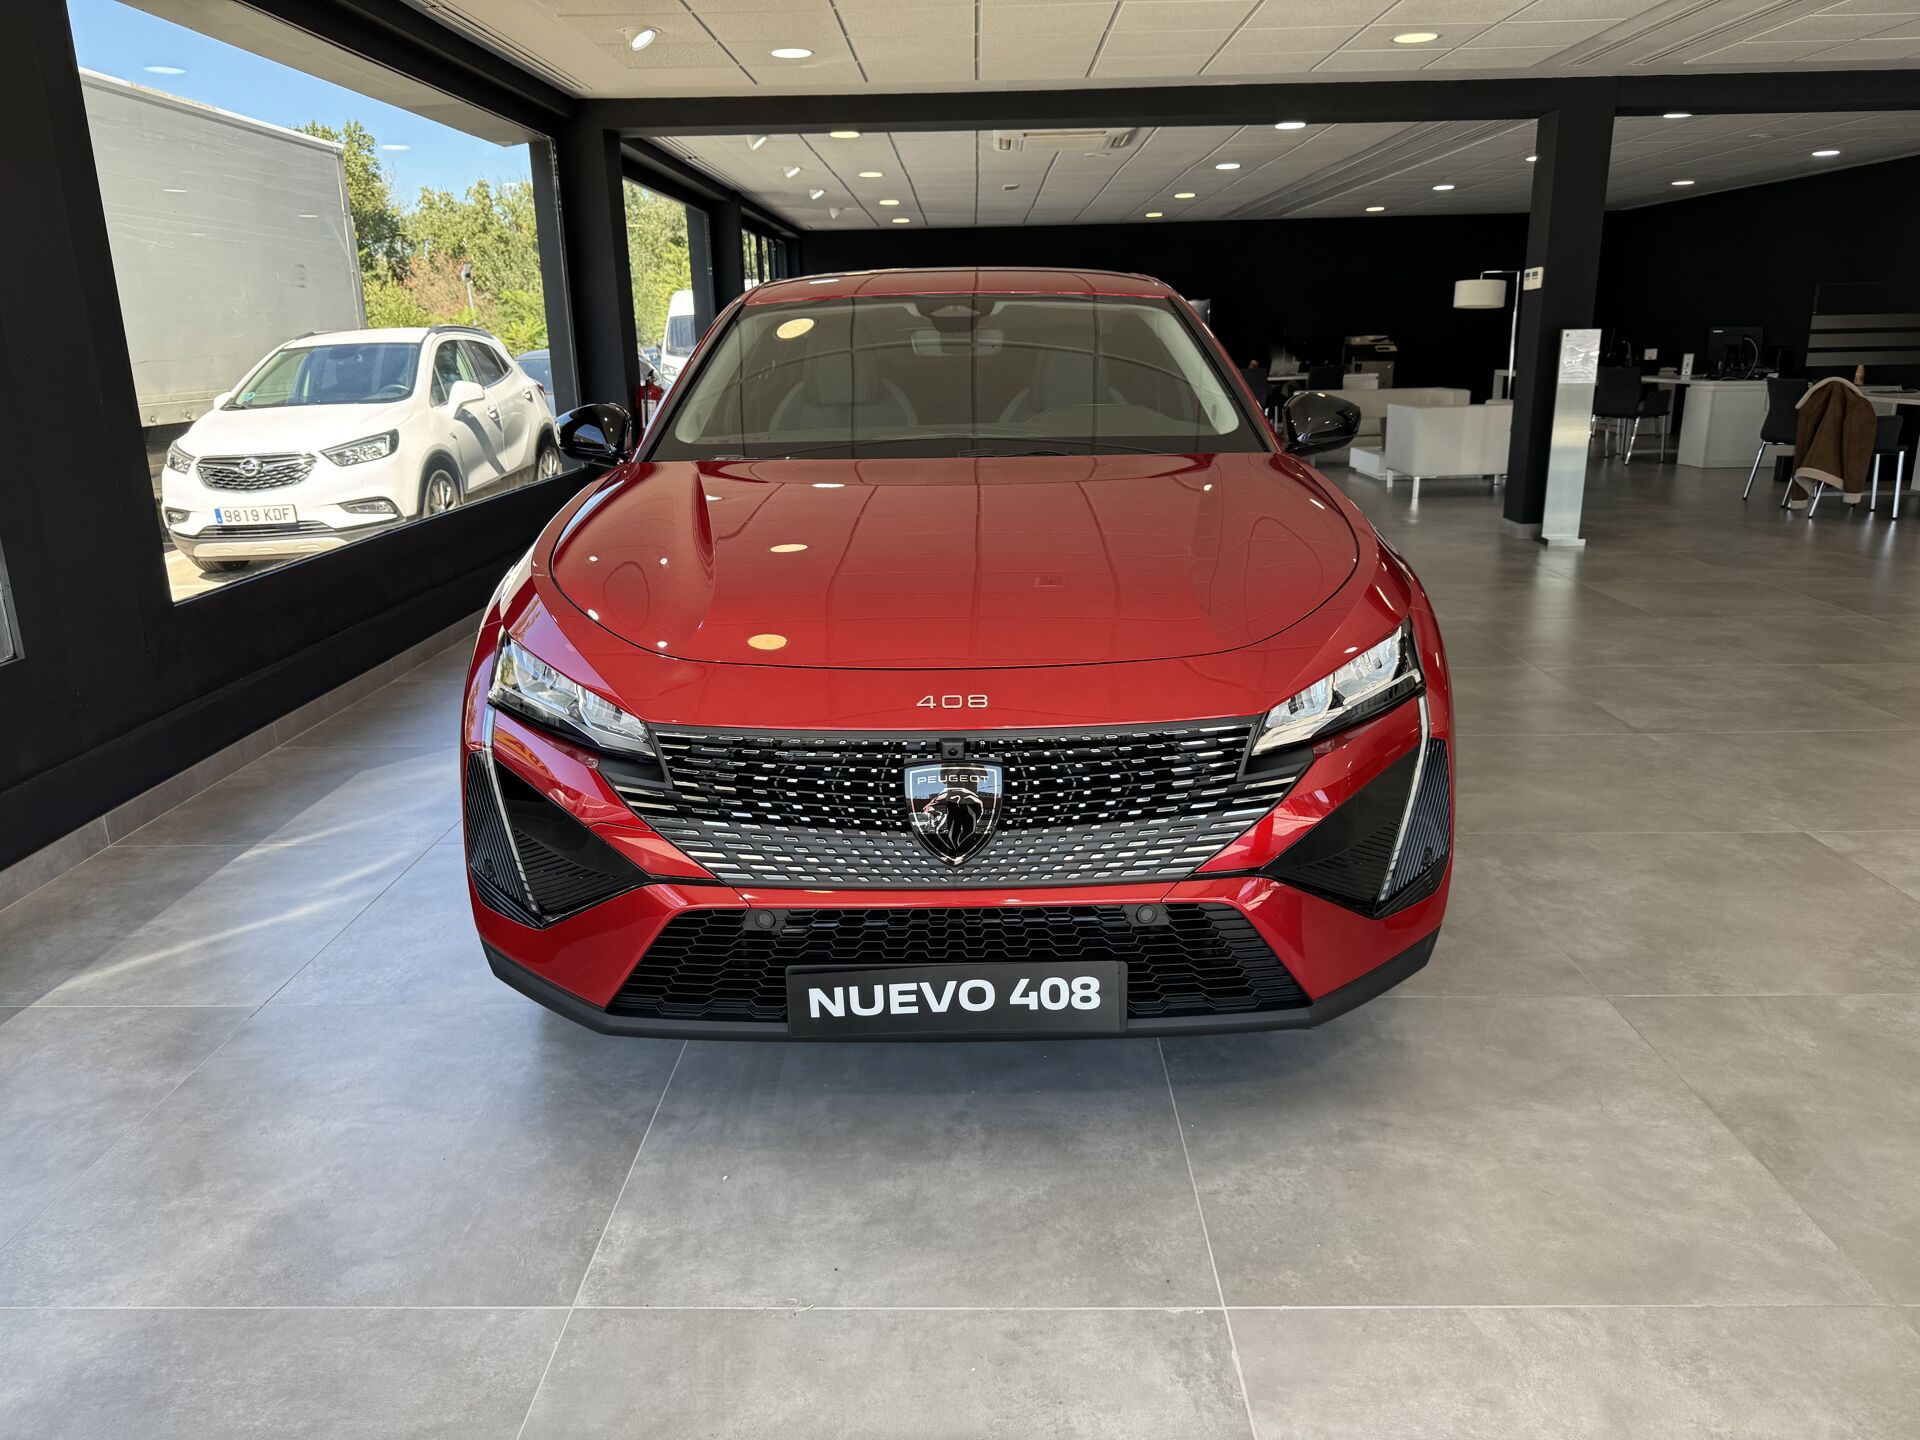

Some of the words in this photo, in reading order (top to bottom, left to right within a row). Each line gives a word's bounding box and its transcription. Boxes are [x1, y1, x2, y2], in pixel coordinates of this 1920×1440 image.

[224, 509, 260, 522] 9819
[264, 508, 290, 521] KDF
[916, 694, 988, 709] 408
[917, 774, 990, 784] PEUGEOT
[808, 979, 996, 1018] NUEVO
[1009, 976, 1101, 1011] 408
